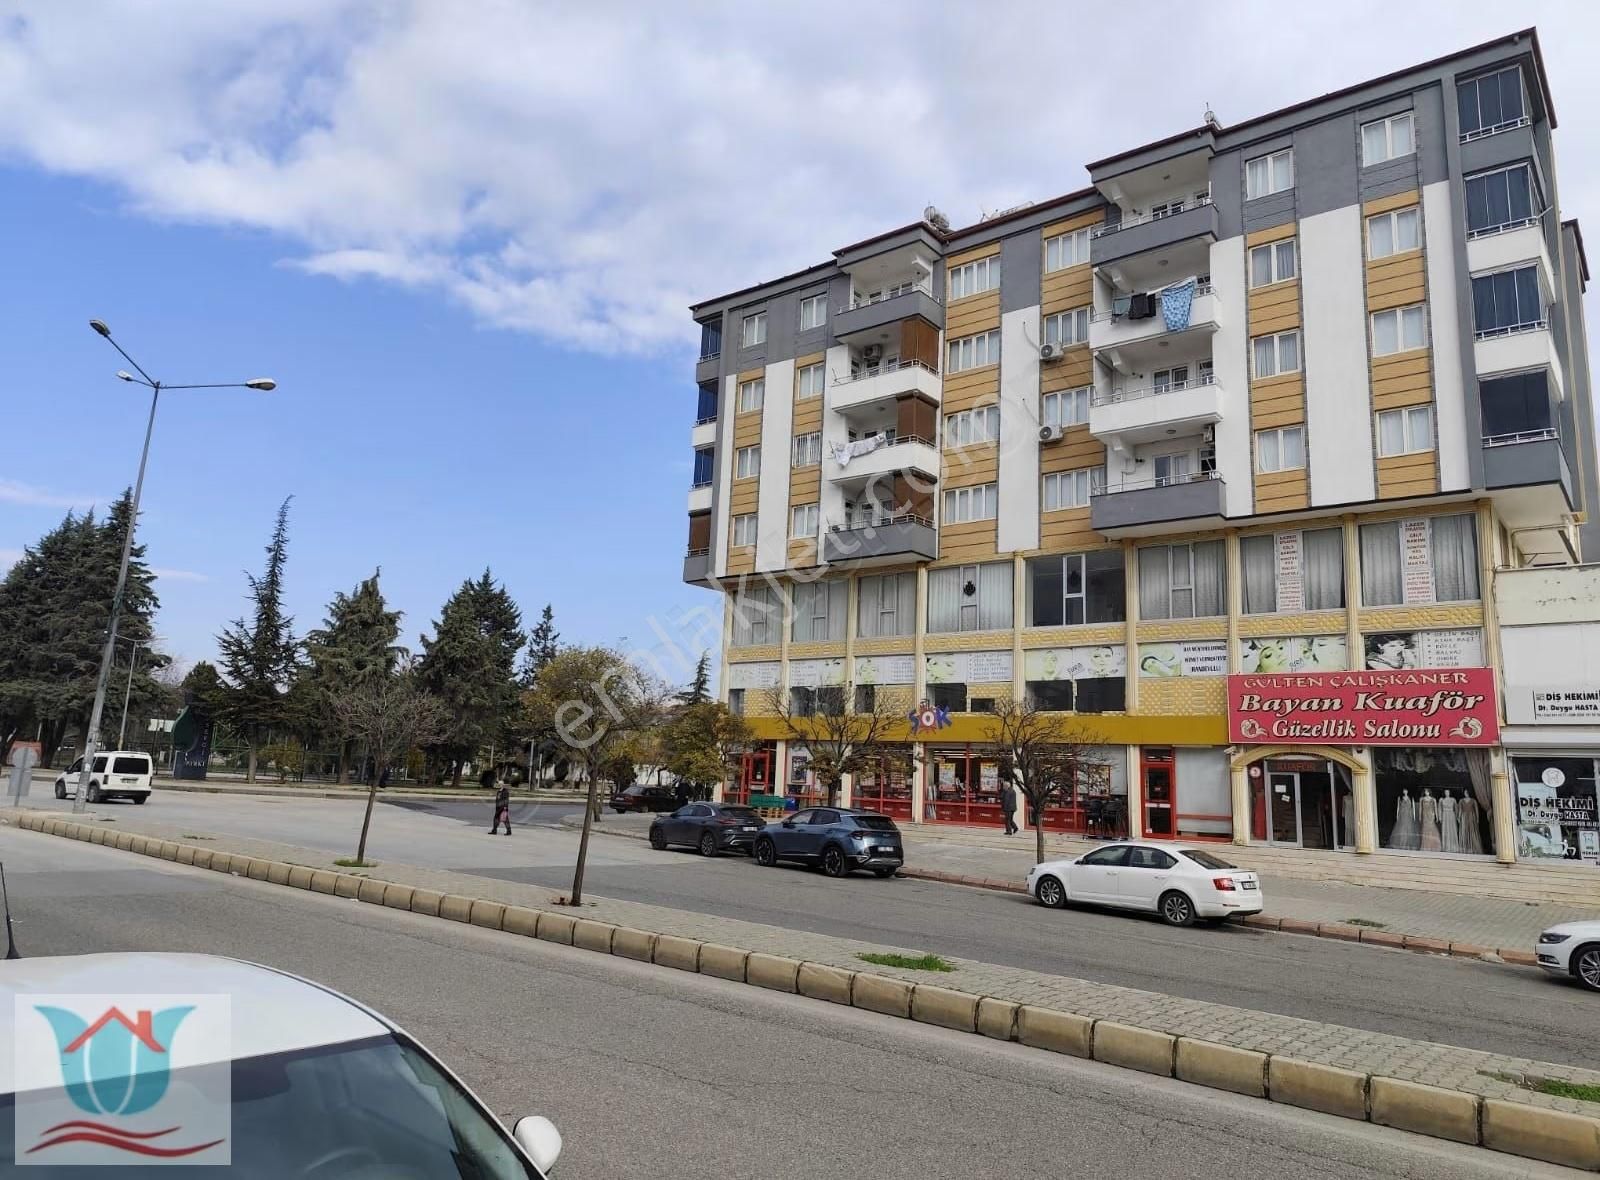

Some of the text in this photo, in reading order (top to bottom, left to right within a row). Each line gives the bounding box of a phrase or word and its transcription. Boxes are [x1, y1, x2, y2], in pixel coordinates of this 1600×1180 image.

[1238, 690, 1486, 717] Bayan Kuaför
[1271, 718, 1442, 739] Güzellik Salonu
[1545, 796, 1594, 810] HEKİMİ
[1540, 810, 1564, 820] Duygu
[1564, 810, 1590, 820] HASTA
